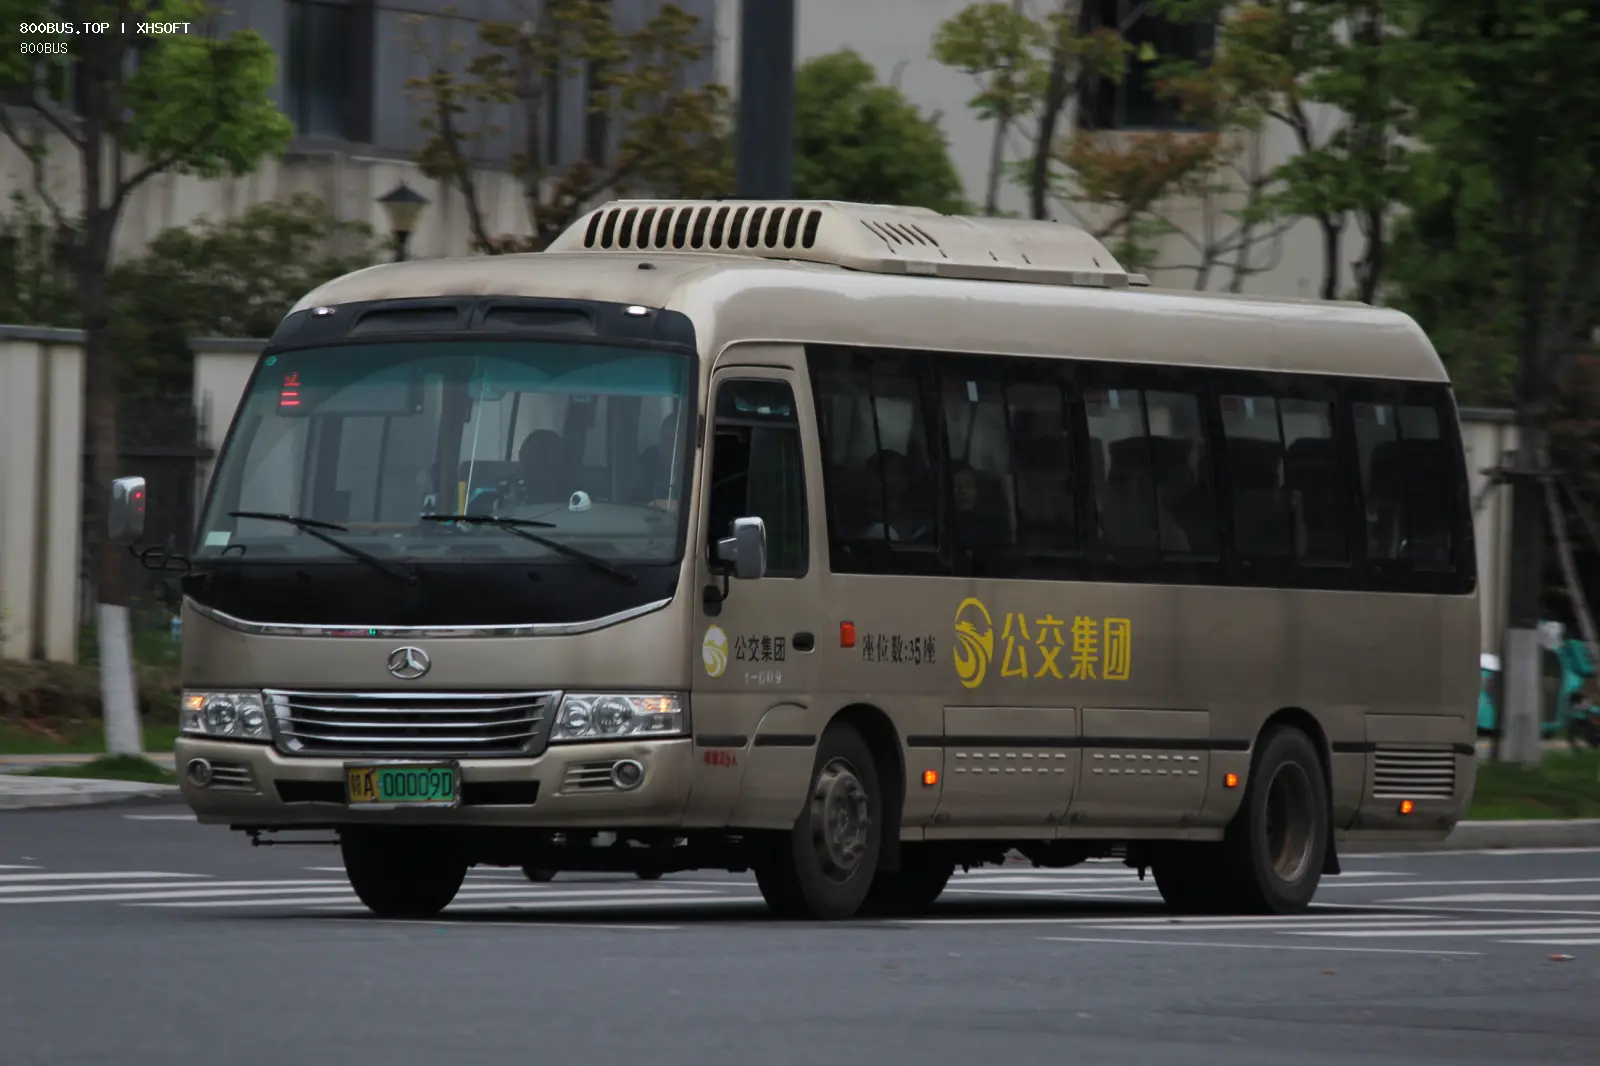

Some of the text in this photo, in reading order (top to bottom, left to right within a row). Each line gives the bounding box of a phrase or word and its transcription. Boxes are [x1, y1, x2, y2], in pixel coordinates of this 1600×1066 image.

[734, 634, 786, 662] 公交集团
[1001, 612, 1132, 681] 公交集团
